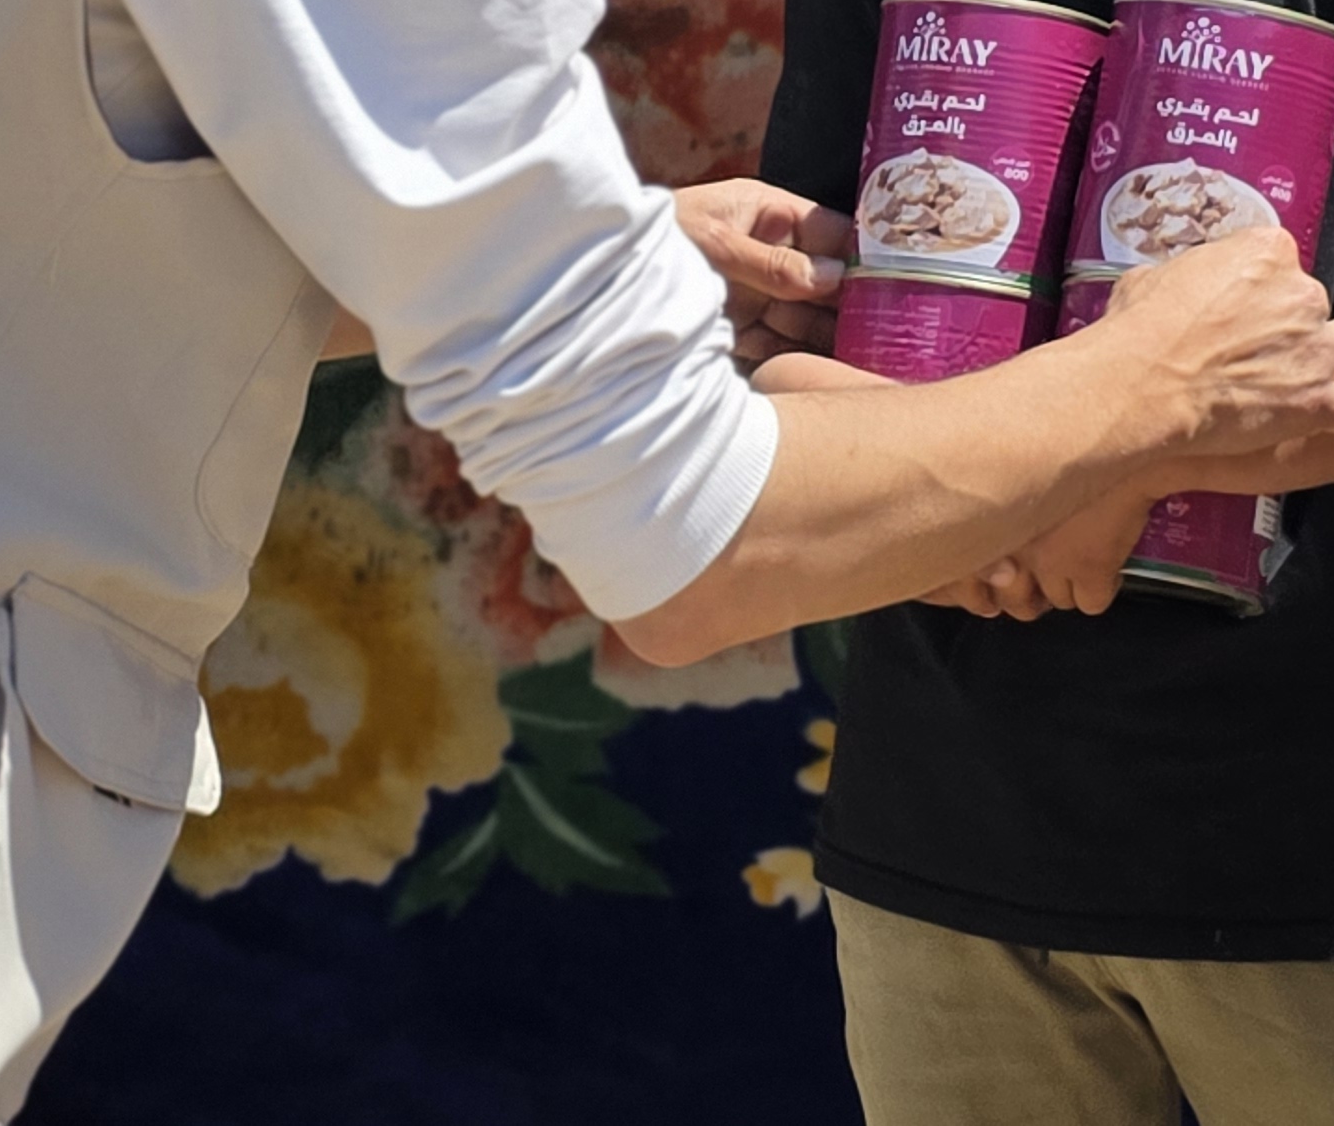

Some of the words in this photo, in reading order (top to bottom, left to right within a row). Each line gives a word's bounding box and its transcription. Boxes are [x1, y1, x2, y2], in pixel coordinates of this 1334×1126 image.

[893, 89, 940, 113] بقري
[942, 93, 987, 112] لحم
[1156, 97, 1211, 123] بقري
[901, 114, 967, 141] بالمرق
[1213, 108, 1260, 127] لحم
[1166, 122, 1238, 155] بالمرق
